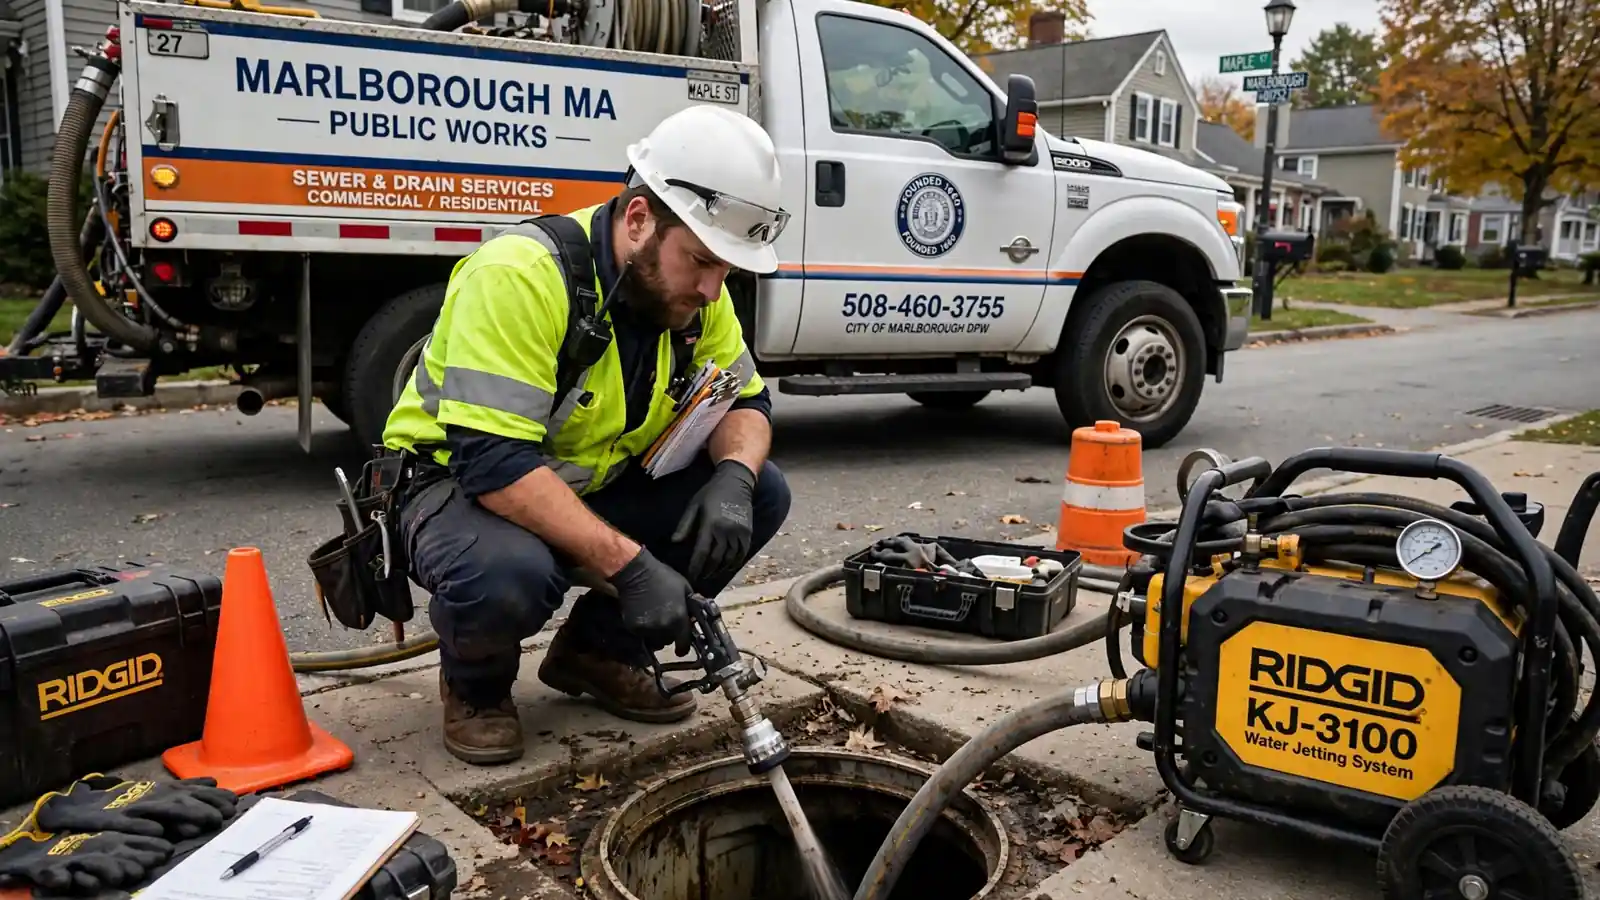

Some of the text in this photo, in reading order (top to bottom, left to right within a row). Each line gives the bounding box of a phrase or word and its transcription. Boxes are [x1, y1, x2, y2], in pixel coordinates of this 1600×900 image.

[156, 33, 183, 53] 27
[1222, 54, 1255, 71] MAPLE
[236, 56, 617, 120] MARLBOROUGH MA
[688, 83, 738, 100] MAPLE ST
[1246, 74, 1305, 90] MARLBOROUGH
[330, 110, 547, 149] PUBLIC WORKS
[293, 170, 555, 198] SEWER & DRAIN SERVICES
[901, 176, 942, 204] FOUNDED
[307, 189, 542, 213] COMMERCIAL / RESIDENTIAL
[901, 231, 938, 255] FOUNDED
[841, 293, 1005, 319] 508-460-3755
[845, 322, 990, 334] CITY OF MARLBOROUGH DPW
[38, 652, 162, 712] RIDGID
[1250, 647, 1425, 711] RIDGID
[1247, 697, 1418, 760] KJ-3100
[1245, 730, 1413, 780] Water Jetting System
